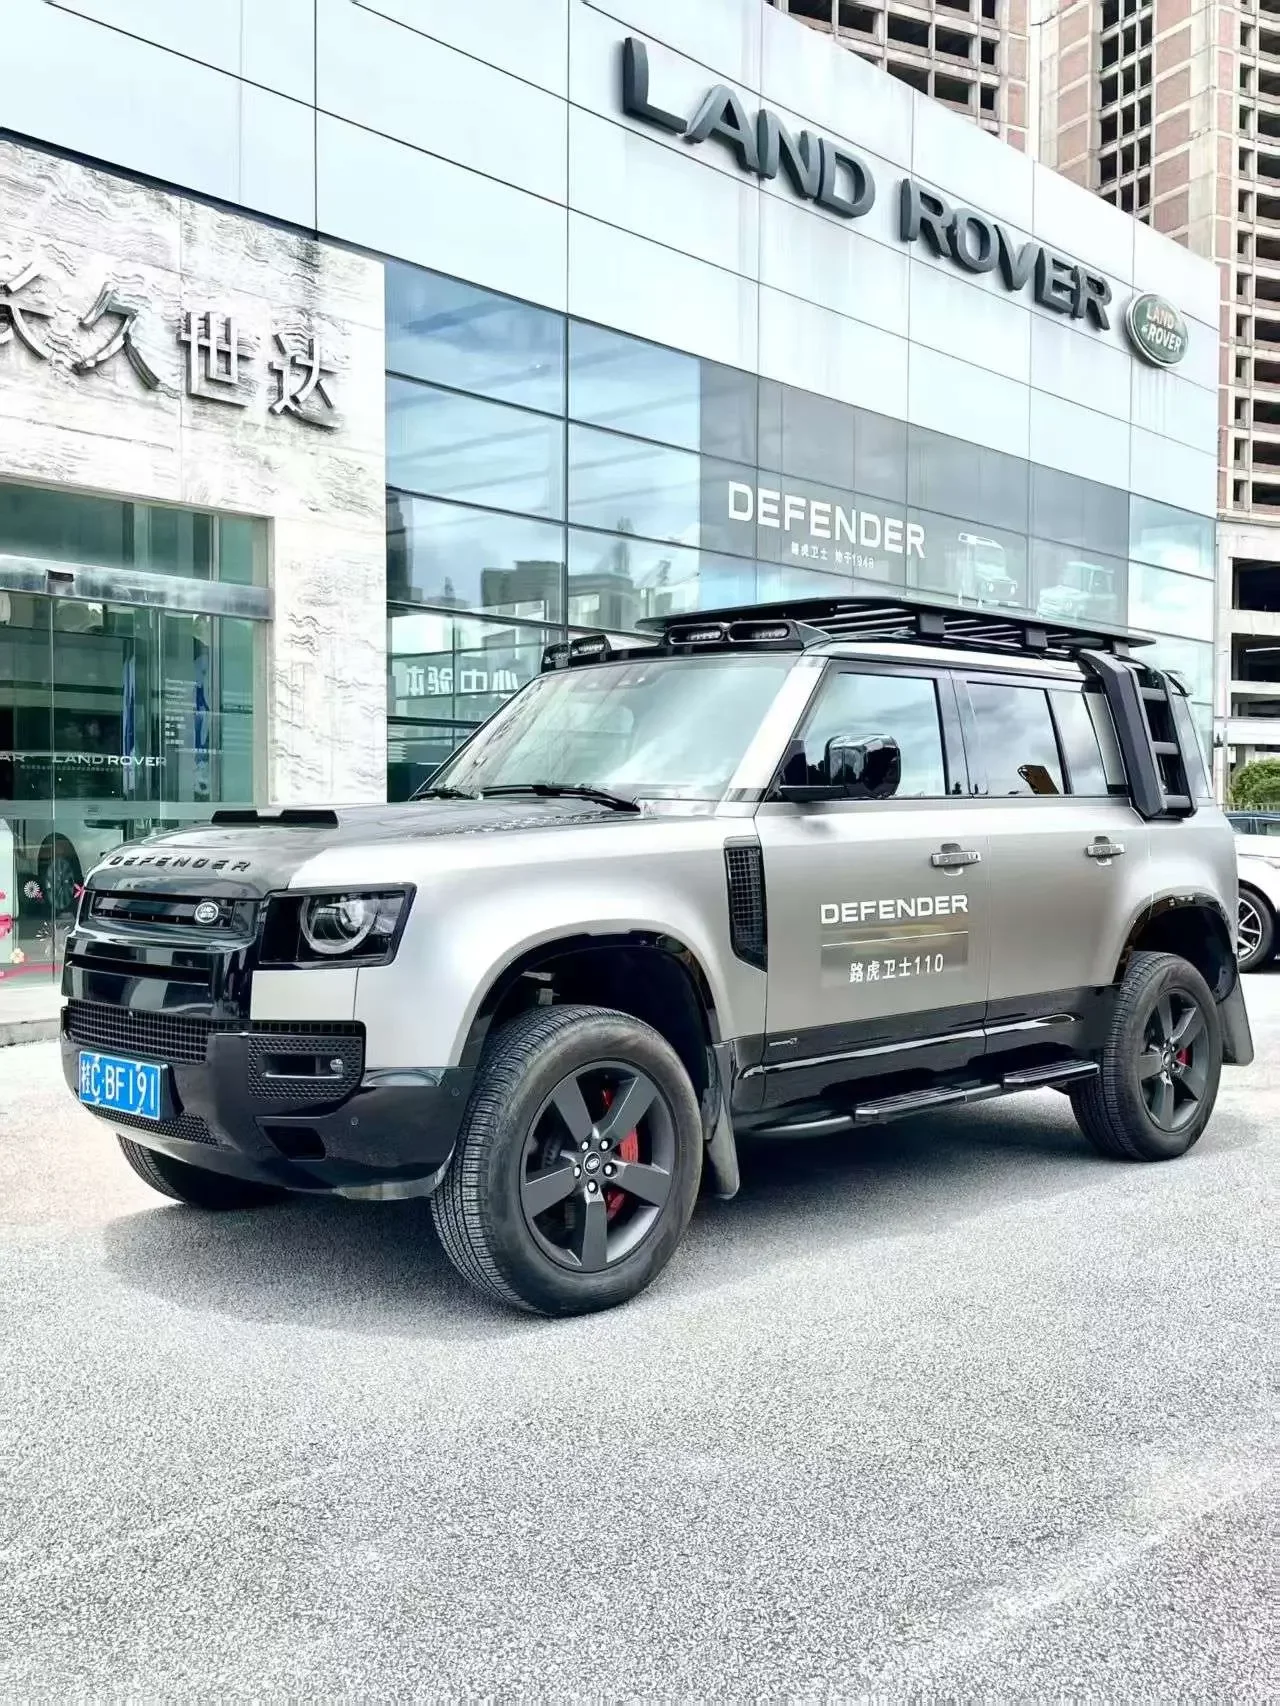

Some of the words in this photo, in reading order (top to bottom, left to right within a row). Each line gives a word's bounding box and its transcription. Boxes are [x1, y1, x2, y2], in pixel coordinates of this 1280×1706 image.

[623, 37, 876, 218] LAND
[900, 178, 1112, 330] ROVER
[1146, 302, 1175, 329] LAND
[1147, 323, 1182, 353] ROVER
[728, 480, 926, 559] DEFENDER
[52, 754, 104, 765] LAND
[107, 755, 167, 767] ROVER
[109, 856, 251, 872] DEFENDER
[820, 894, 969, 924] DEFENDER
[849, 953, 944, 983] 路虎卫士110
